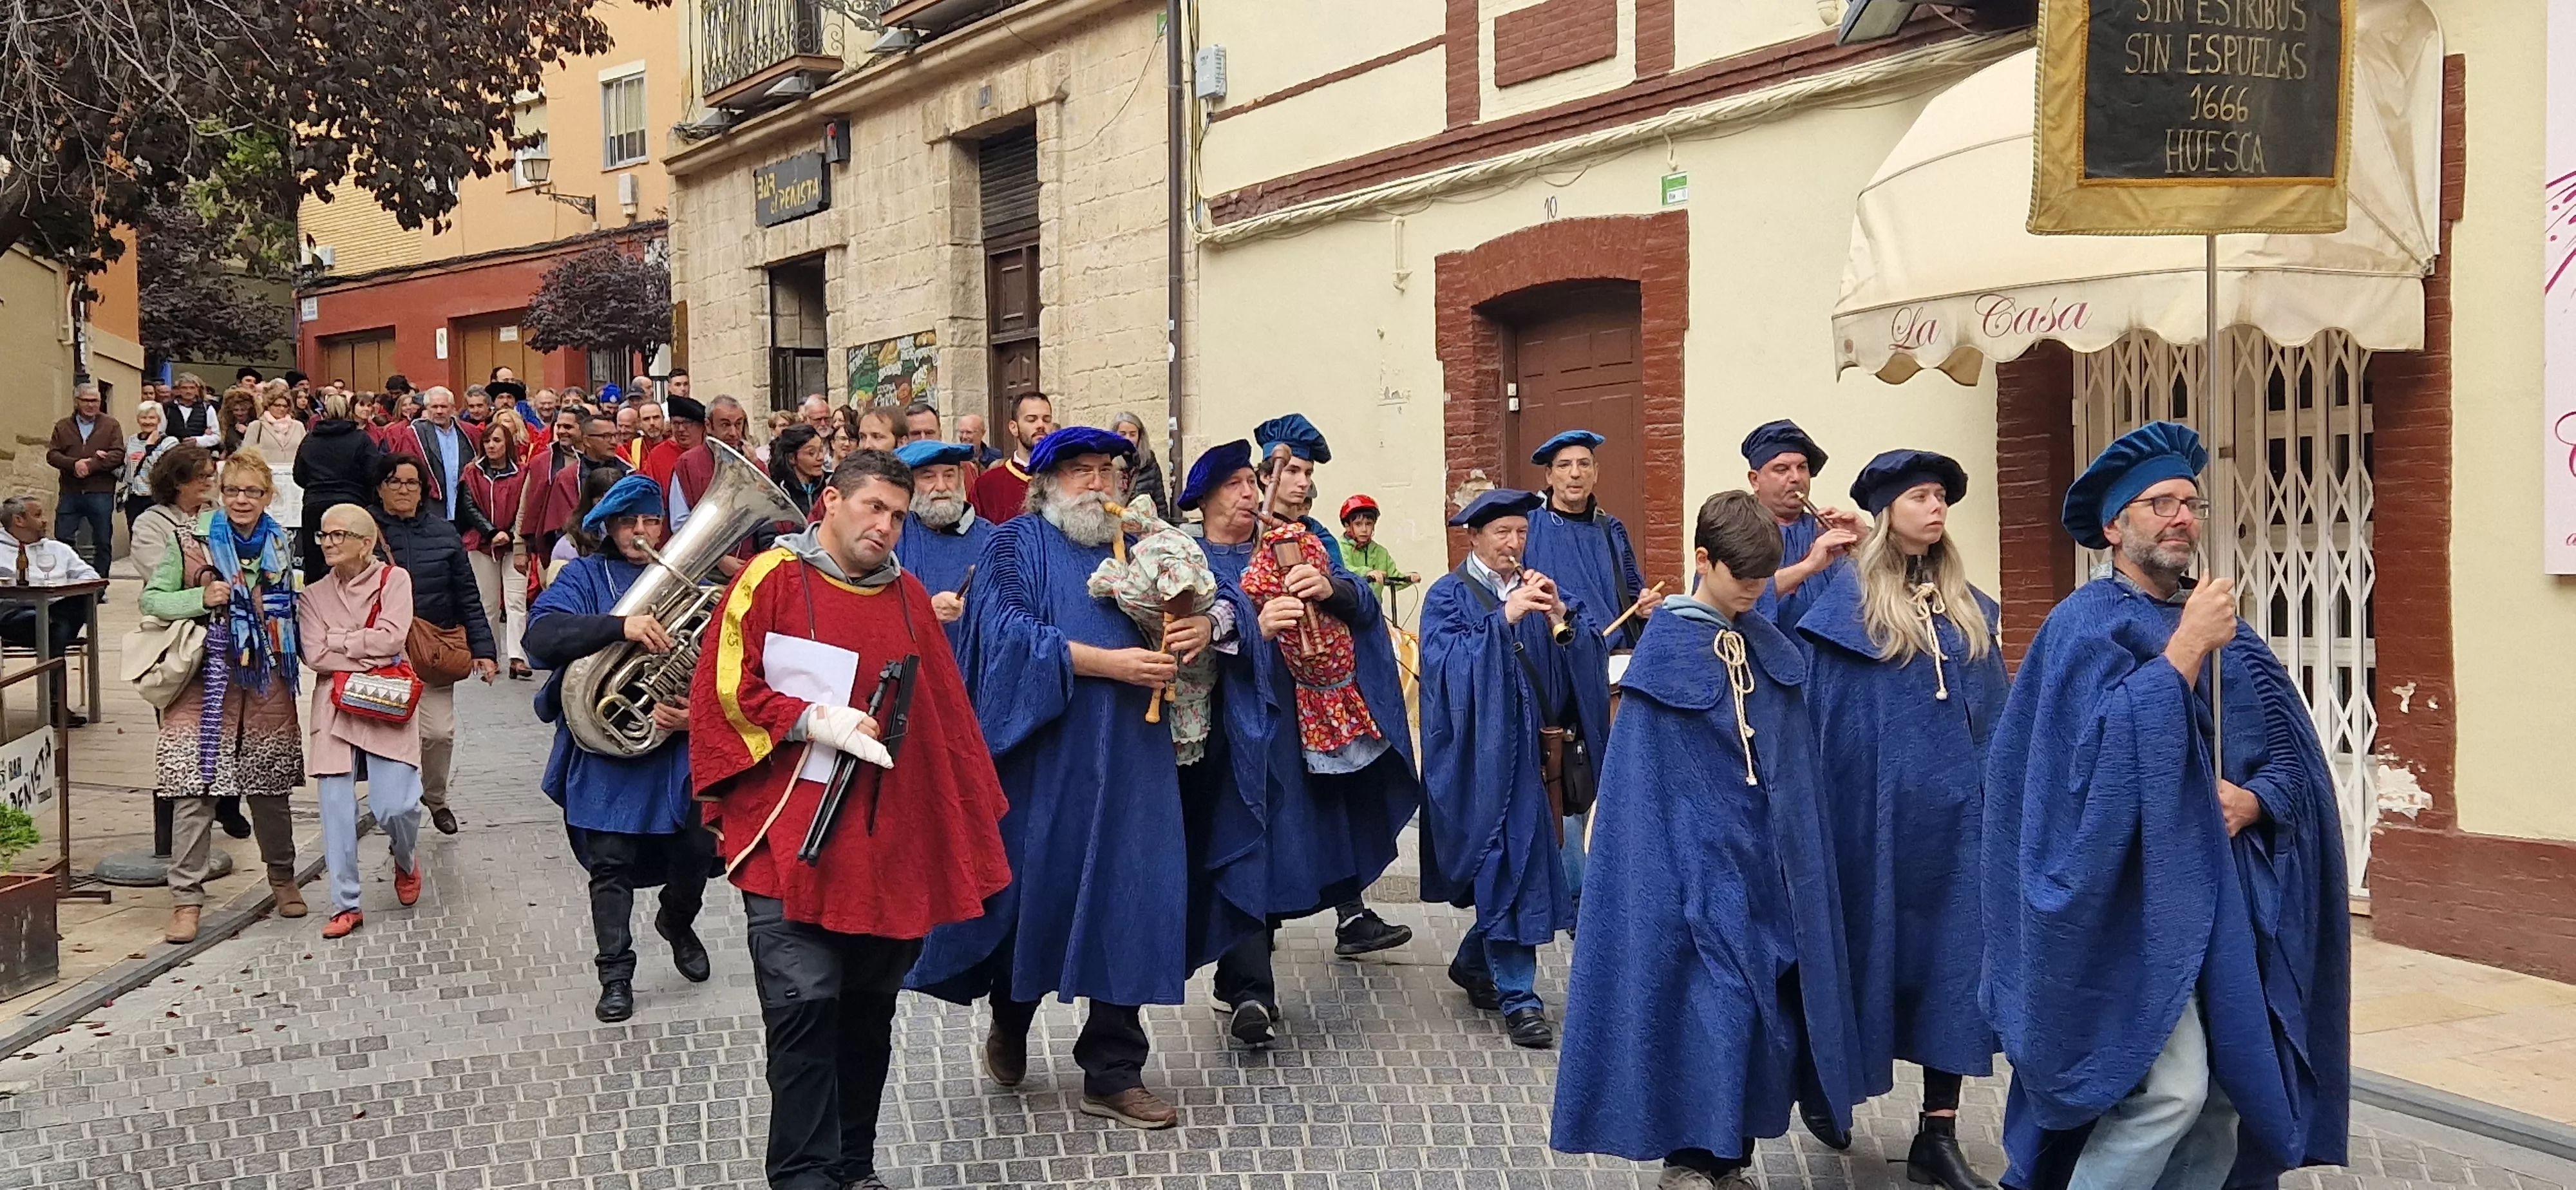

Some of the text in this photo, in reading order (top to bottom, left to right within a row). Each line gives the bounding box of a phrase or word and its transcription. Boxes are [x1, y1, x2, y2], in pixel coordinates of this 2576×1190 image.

[2136, 0, 2184, 23] SIN
[2125, 33, 2307, 80] SIN ESPUELAS
[2190, 82, 2249, 123] 1666
[2164, 129, 2268, 174] HUESCA
[1544, 195, 1558, 221] 10
[1888, 293, 2093, 350] La Casa
